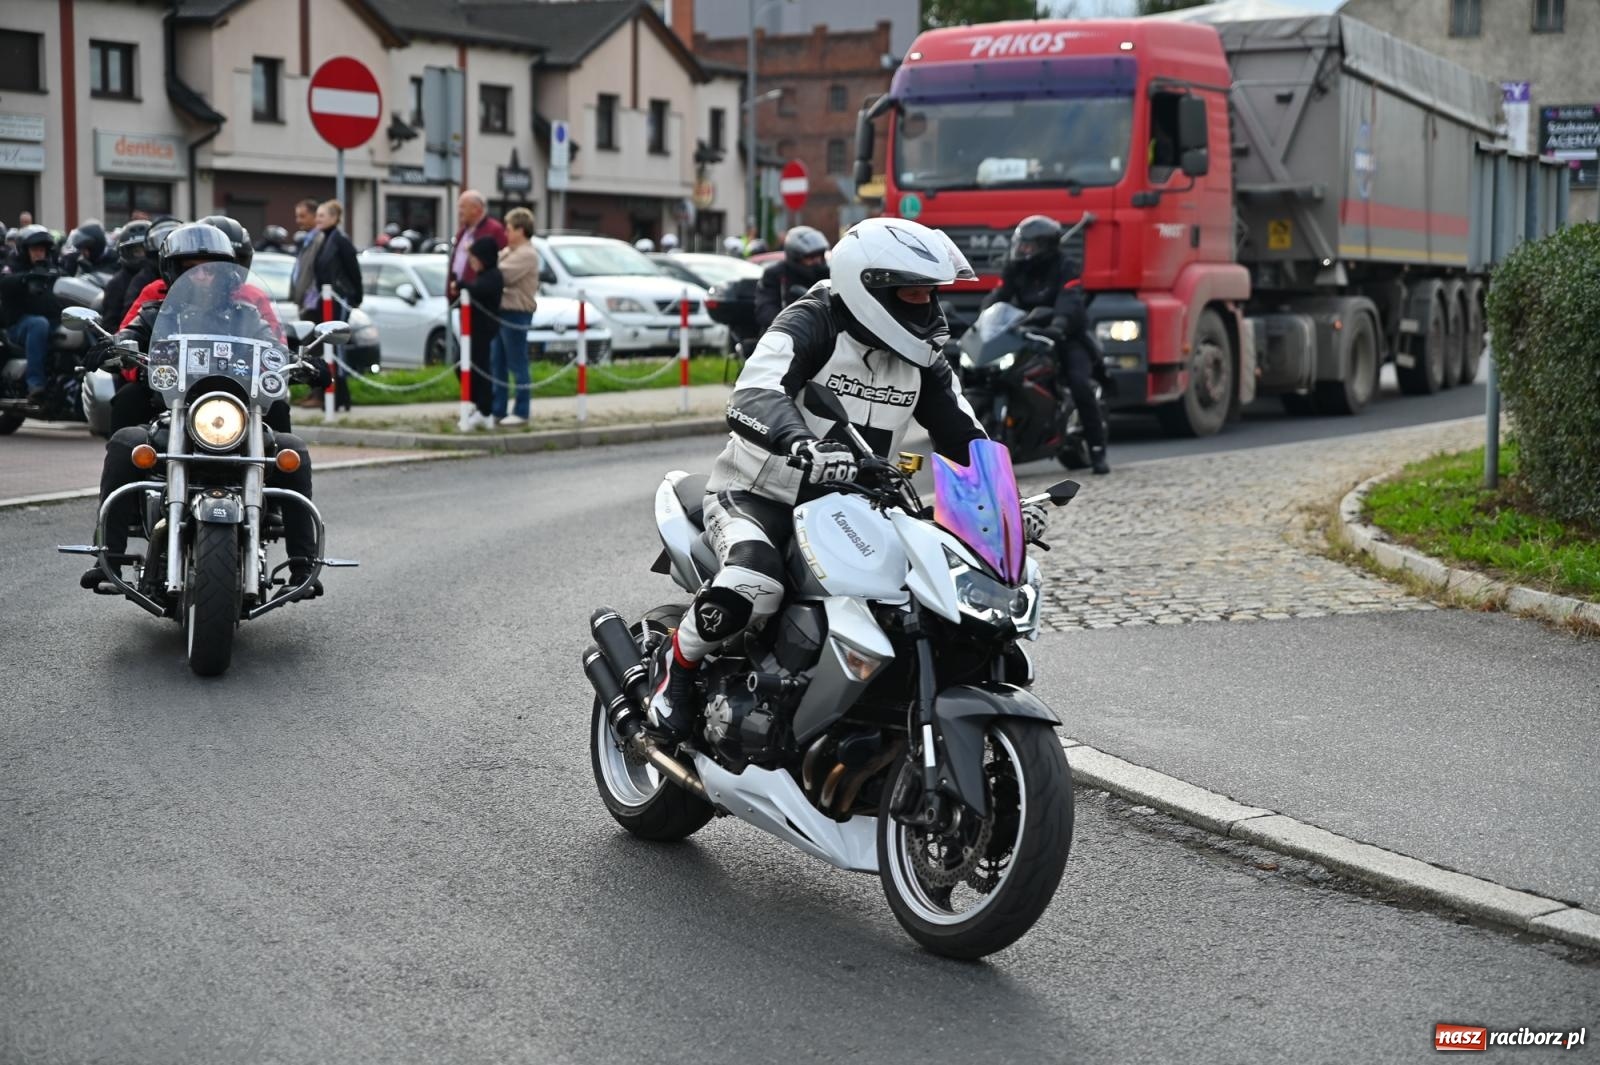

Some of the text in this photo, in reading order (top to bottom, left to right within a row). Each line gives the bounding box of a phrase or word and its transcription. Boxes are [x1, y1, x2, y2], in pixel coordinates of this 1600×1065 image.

[969, 32, 1066, 57] PAKOS
[115, 136, 175, 160] dentica
[827, 375, 916, 407] alpinestars
[831, 511, 875, 557] Kawasaki
